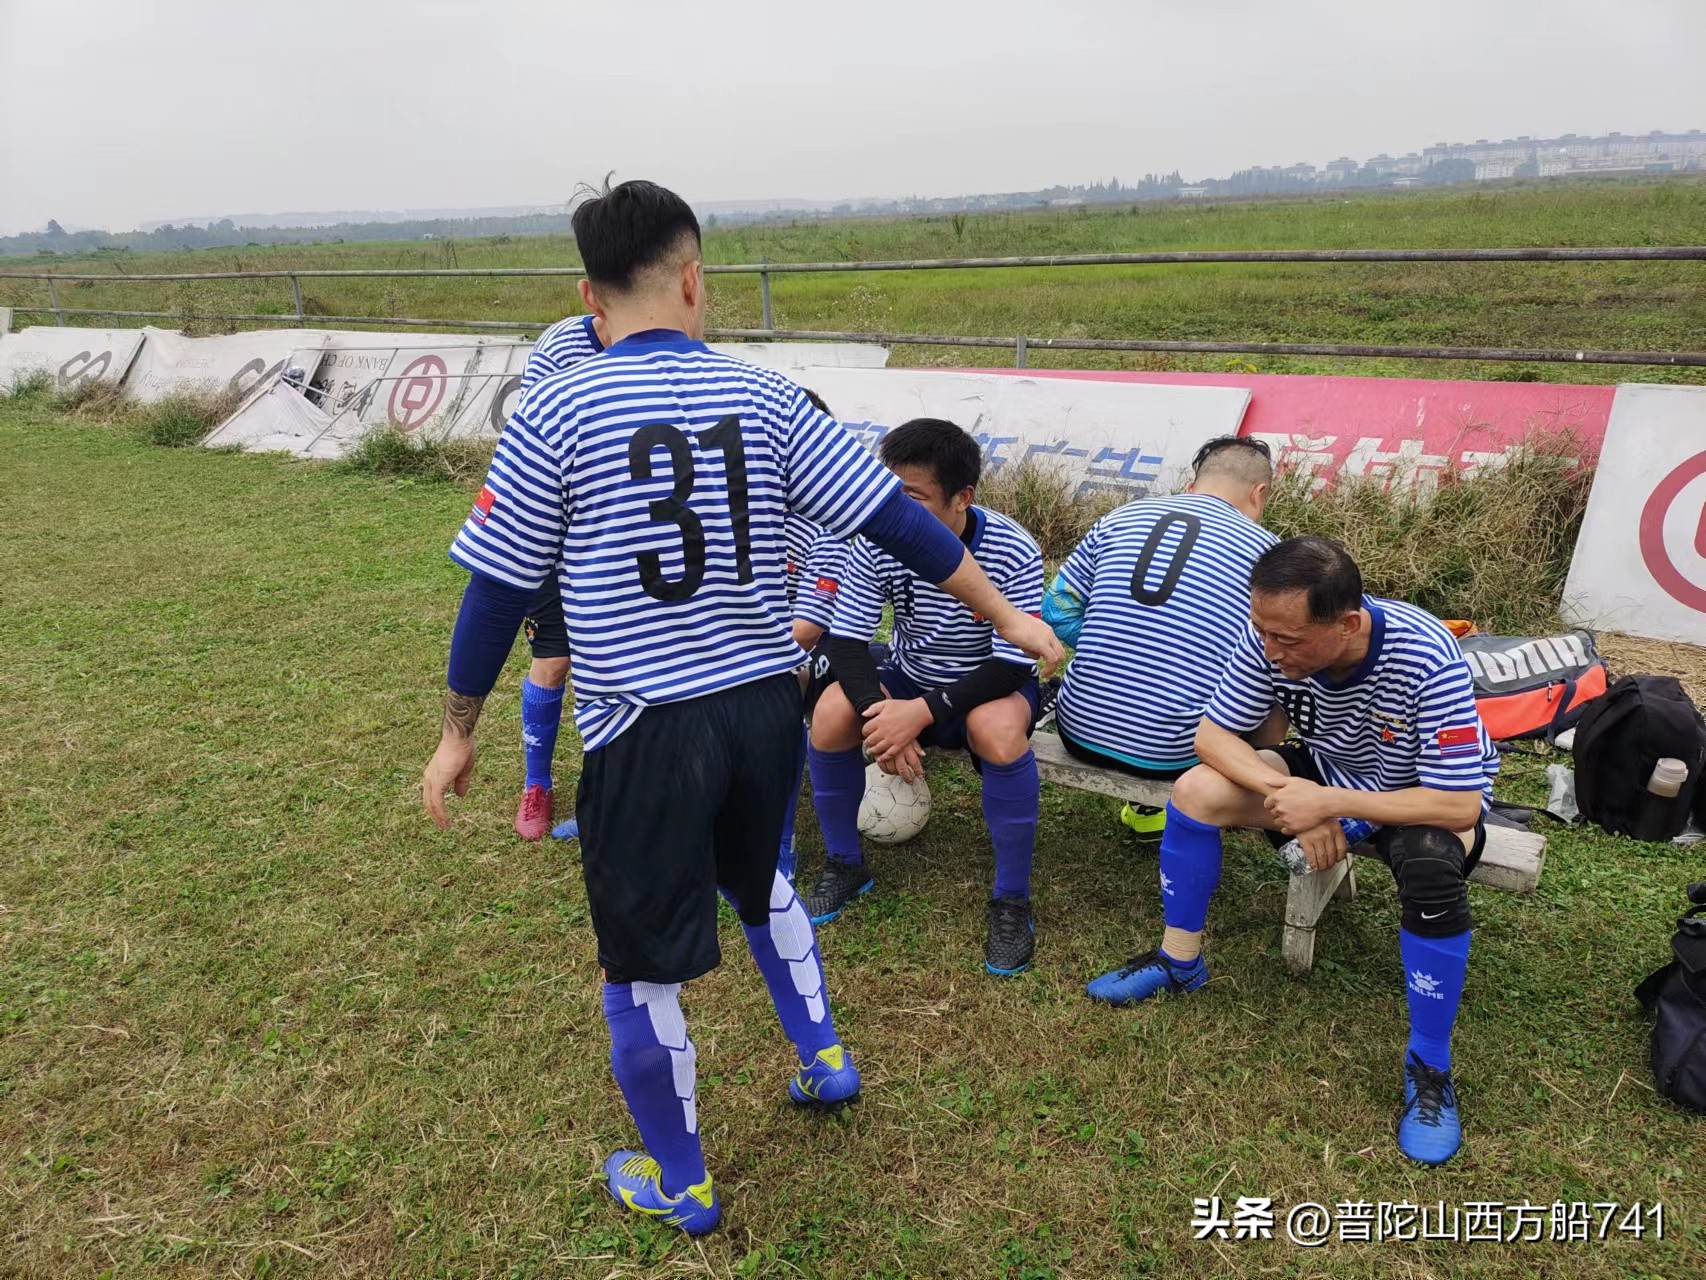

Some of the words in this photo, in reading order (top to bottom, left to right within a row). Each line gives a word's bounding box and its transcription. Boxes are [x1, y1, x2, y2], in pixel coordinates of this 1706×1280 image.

[338, 355, 354, 368] OF
[628, 414, 754, 601] 31
[1130, 511, 1201, 606] 0
[1408, 981, 1444, 1000] KELME
